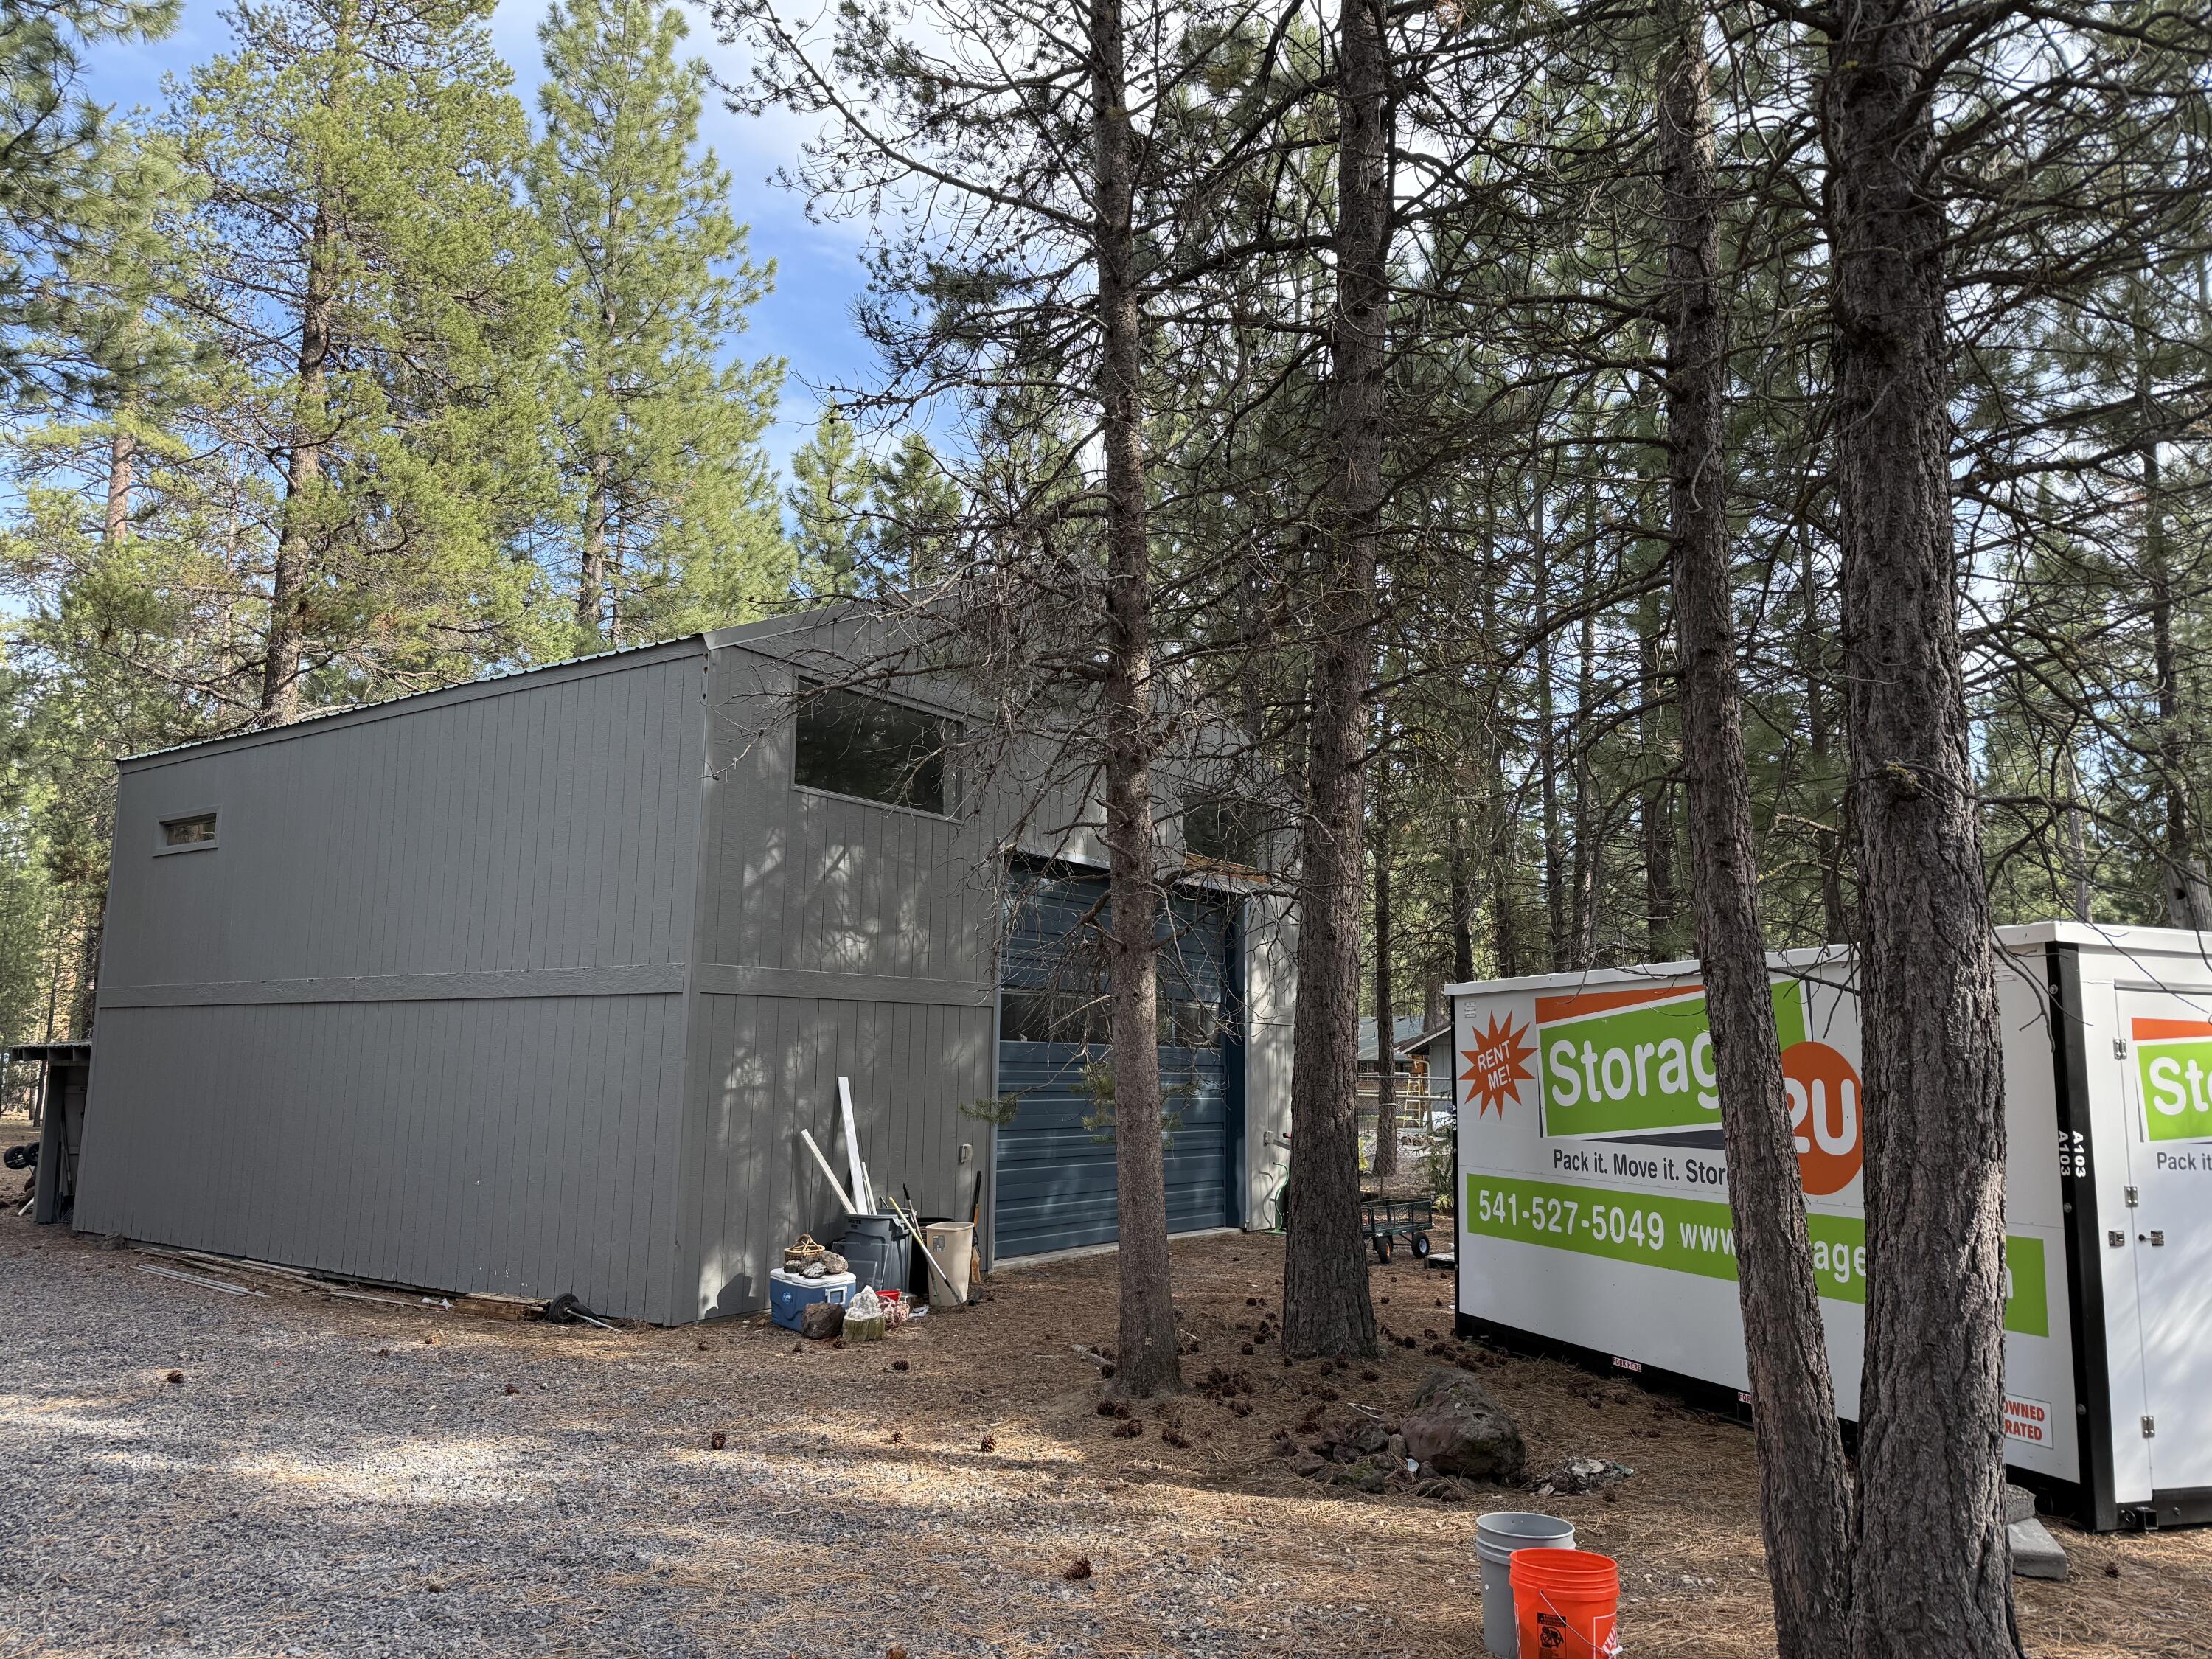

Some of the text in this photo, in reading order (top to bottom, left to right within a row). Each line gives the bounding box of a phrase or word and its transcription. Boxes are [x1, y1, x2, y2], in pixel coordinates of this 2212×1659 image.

[1477, 1040, 1510, 1074] RENT
[1487, 1064, 1512, 1091] ME!
[1549, 1031, 1857, 1156] Storag 2U
[2149, 1057, 2212, 1116] St
[1554, 1148, 1726, 1186] Pack it. Move it. Stor
[2058, 1130, 2071, 1176] A103
[2073, 1130, 2087, 1178] A103
[2157, 1152, 2197, 1171] Pack
[1479, 1189, 1665, 1251] 541-527-5049
[1613, 1357, 1641, 1371] FORK HERE
[1739, 1393, 1752, 1402] FOR
[2004, 1419, 2042, 1441] RATED
